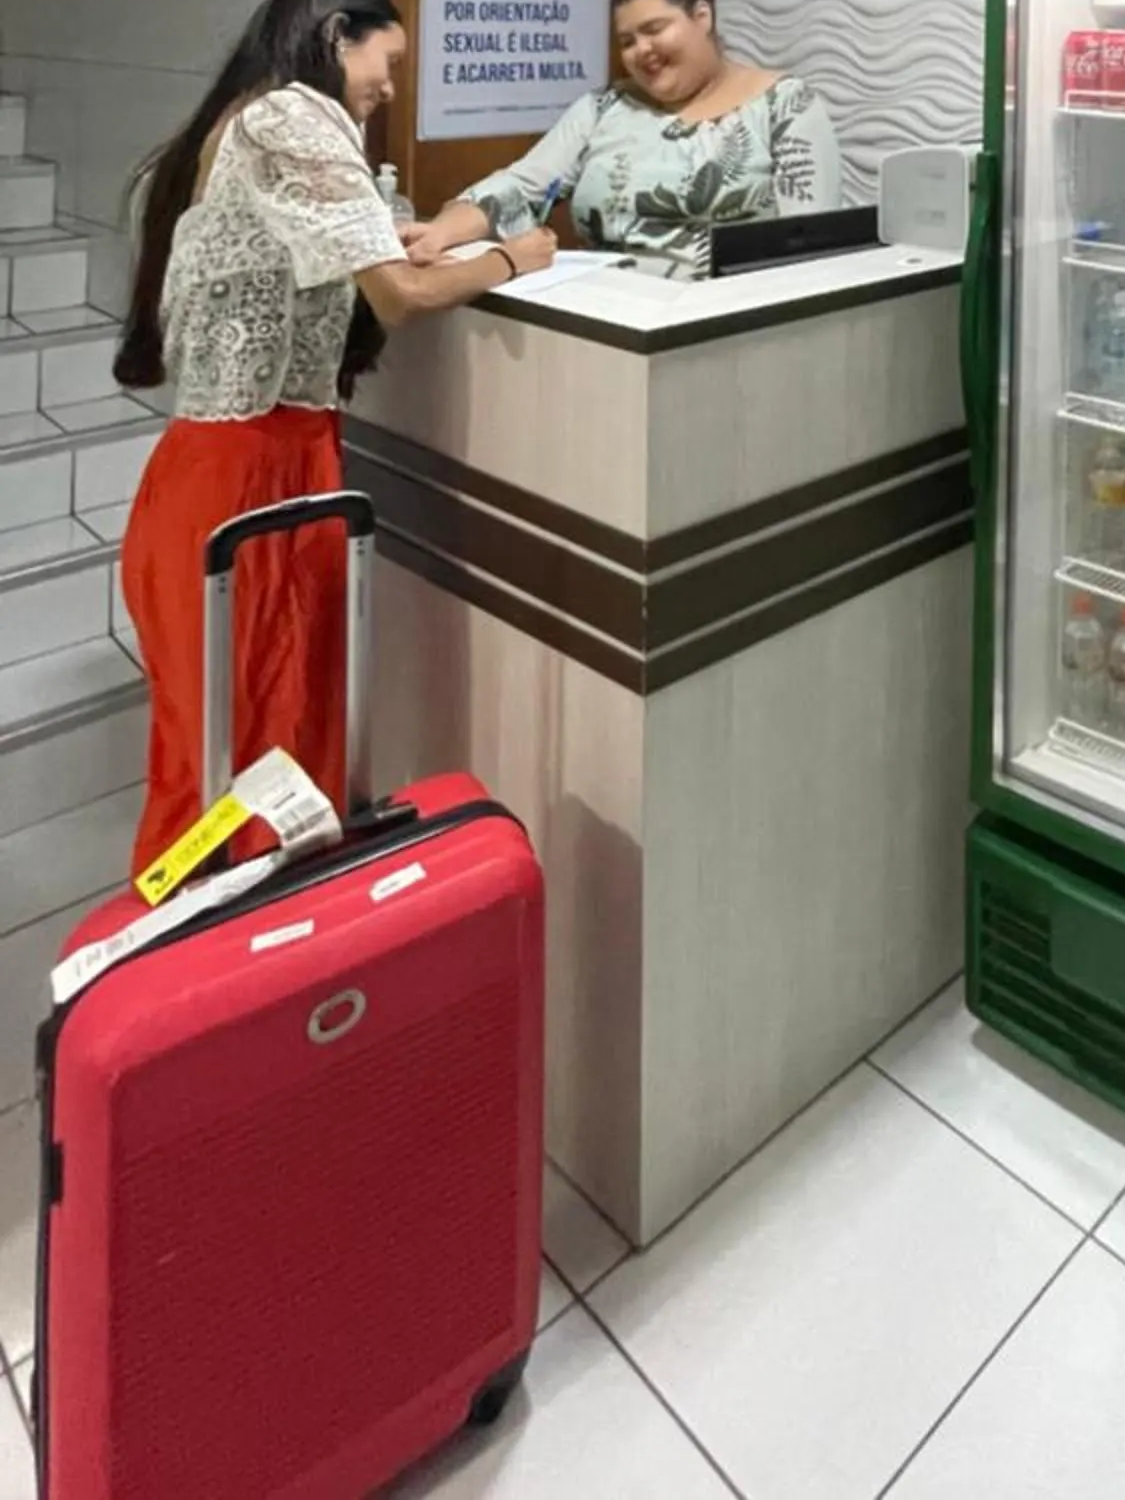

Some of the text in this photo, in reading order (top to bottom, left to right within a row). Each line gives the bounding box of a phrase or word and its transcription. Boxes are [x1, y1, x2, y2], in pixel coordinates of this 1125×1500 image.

[444, 0, 570, 25] POR ORIENTAÇÃO
[443, 30, 569, 53] SEXUAL É ILEGAL
[443, 60, 587, 84] E ACARRETA MULTA.
